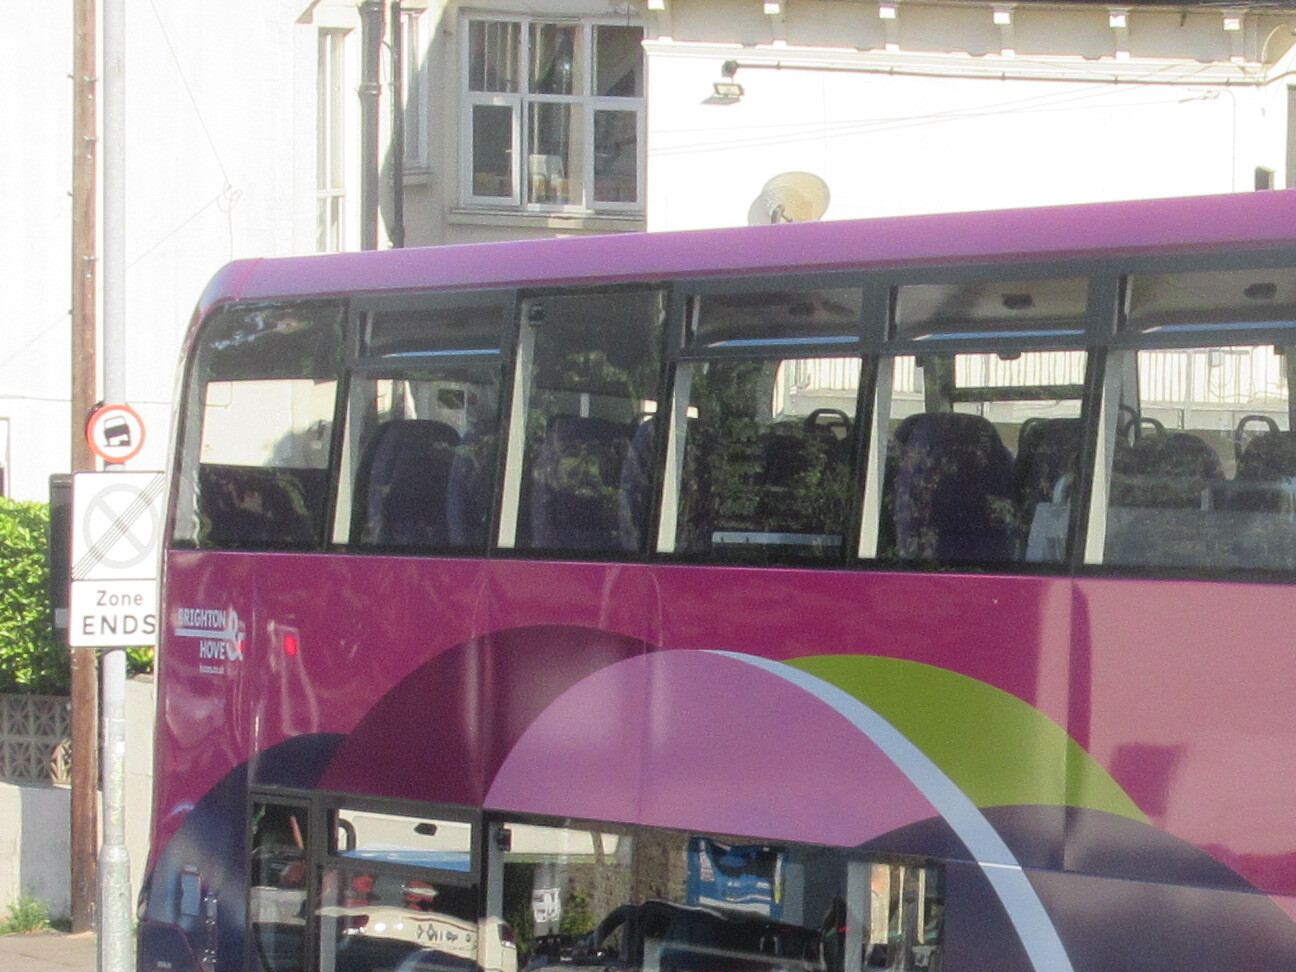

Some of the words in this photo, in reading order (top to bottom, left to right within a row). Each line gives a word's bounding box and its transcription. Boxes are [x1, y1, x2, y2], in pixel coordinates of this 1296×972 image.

[96, 590, 144, 606] Zone
[82, 614, 157, 635] ENDS
[176, 607, 226, 628] BRIGHTON
[200, 640, 226, 660] HOVE
